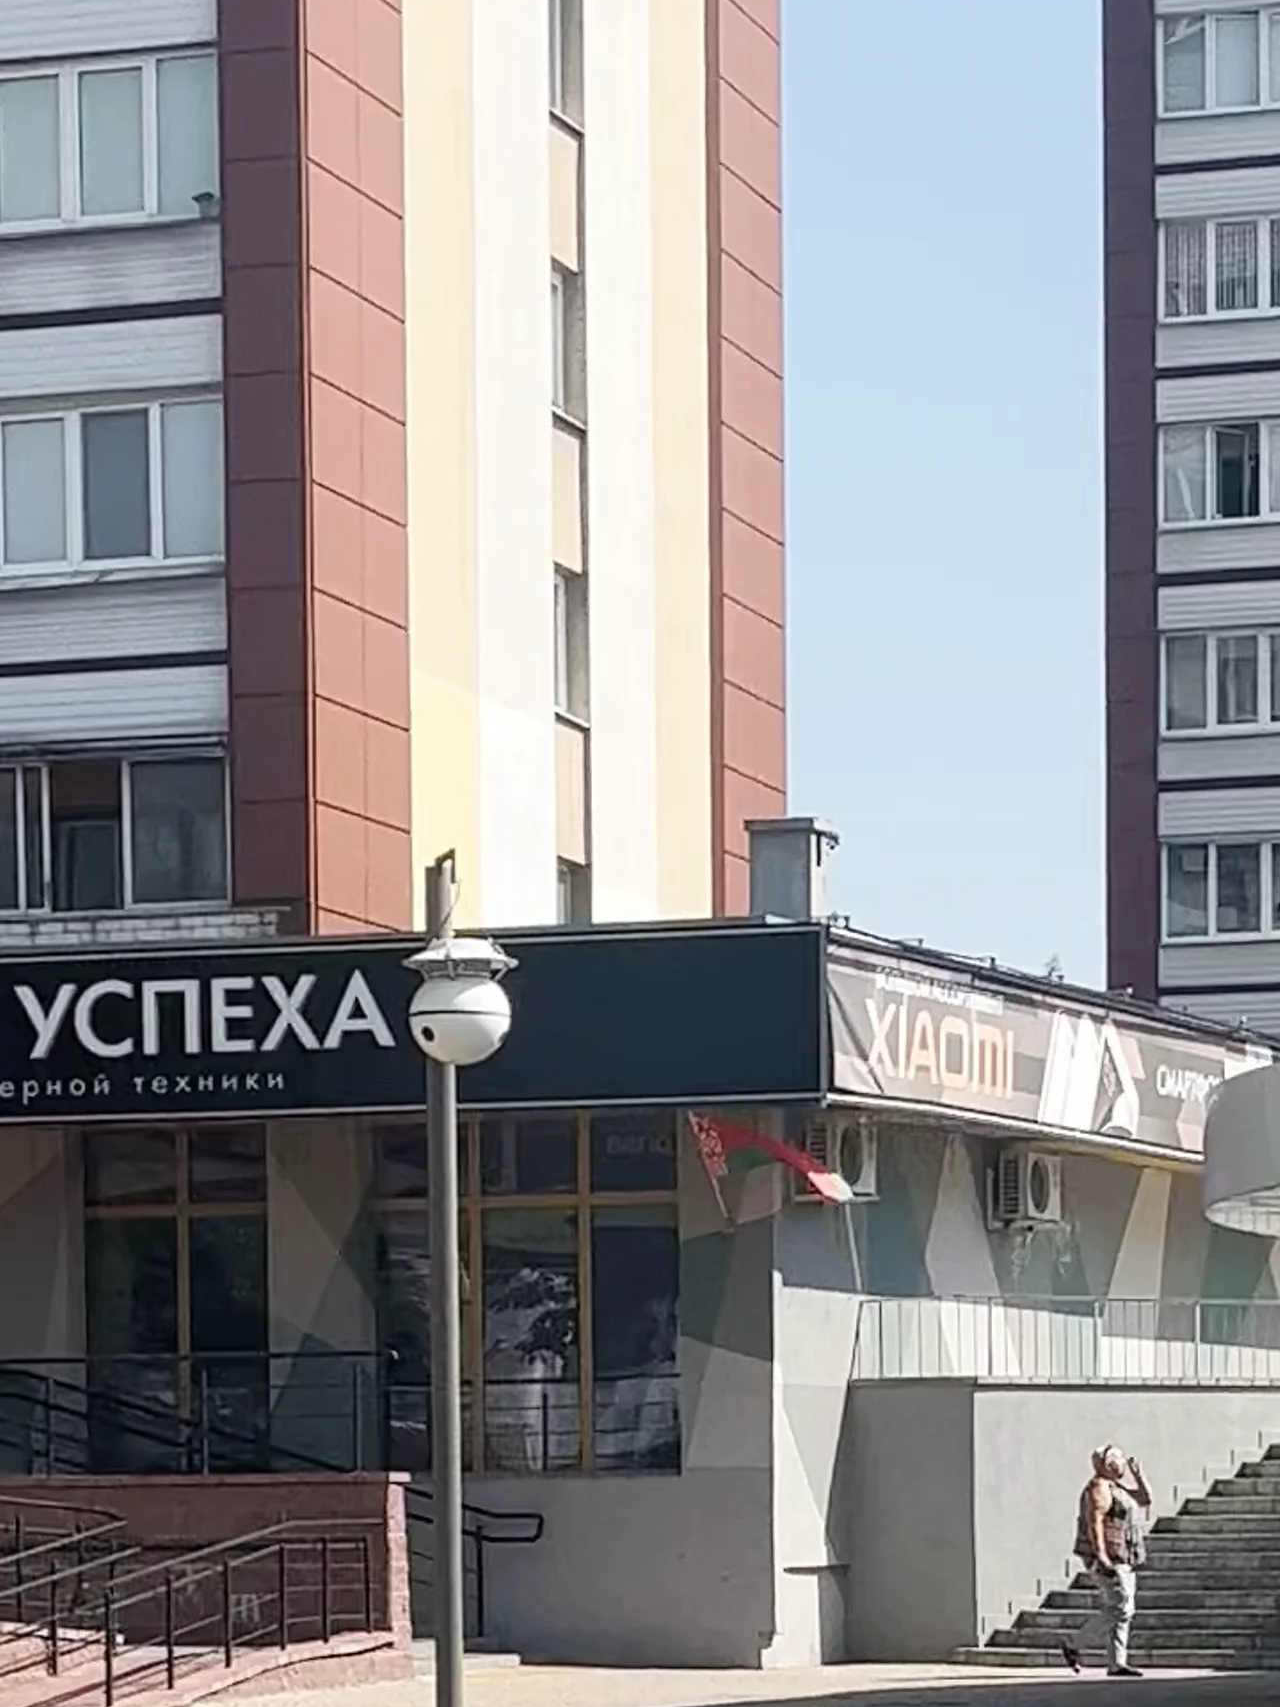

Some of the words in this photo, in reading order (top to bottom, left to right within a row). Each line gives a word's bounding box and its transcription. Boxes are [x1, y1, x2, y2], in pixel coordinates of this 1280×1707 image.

[14, 969, 396, 1059] УСПЕХА
[866, 996, 1014, 1100] XIAOMI
[134, 1071, 285, 1094] техники
